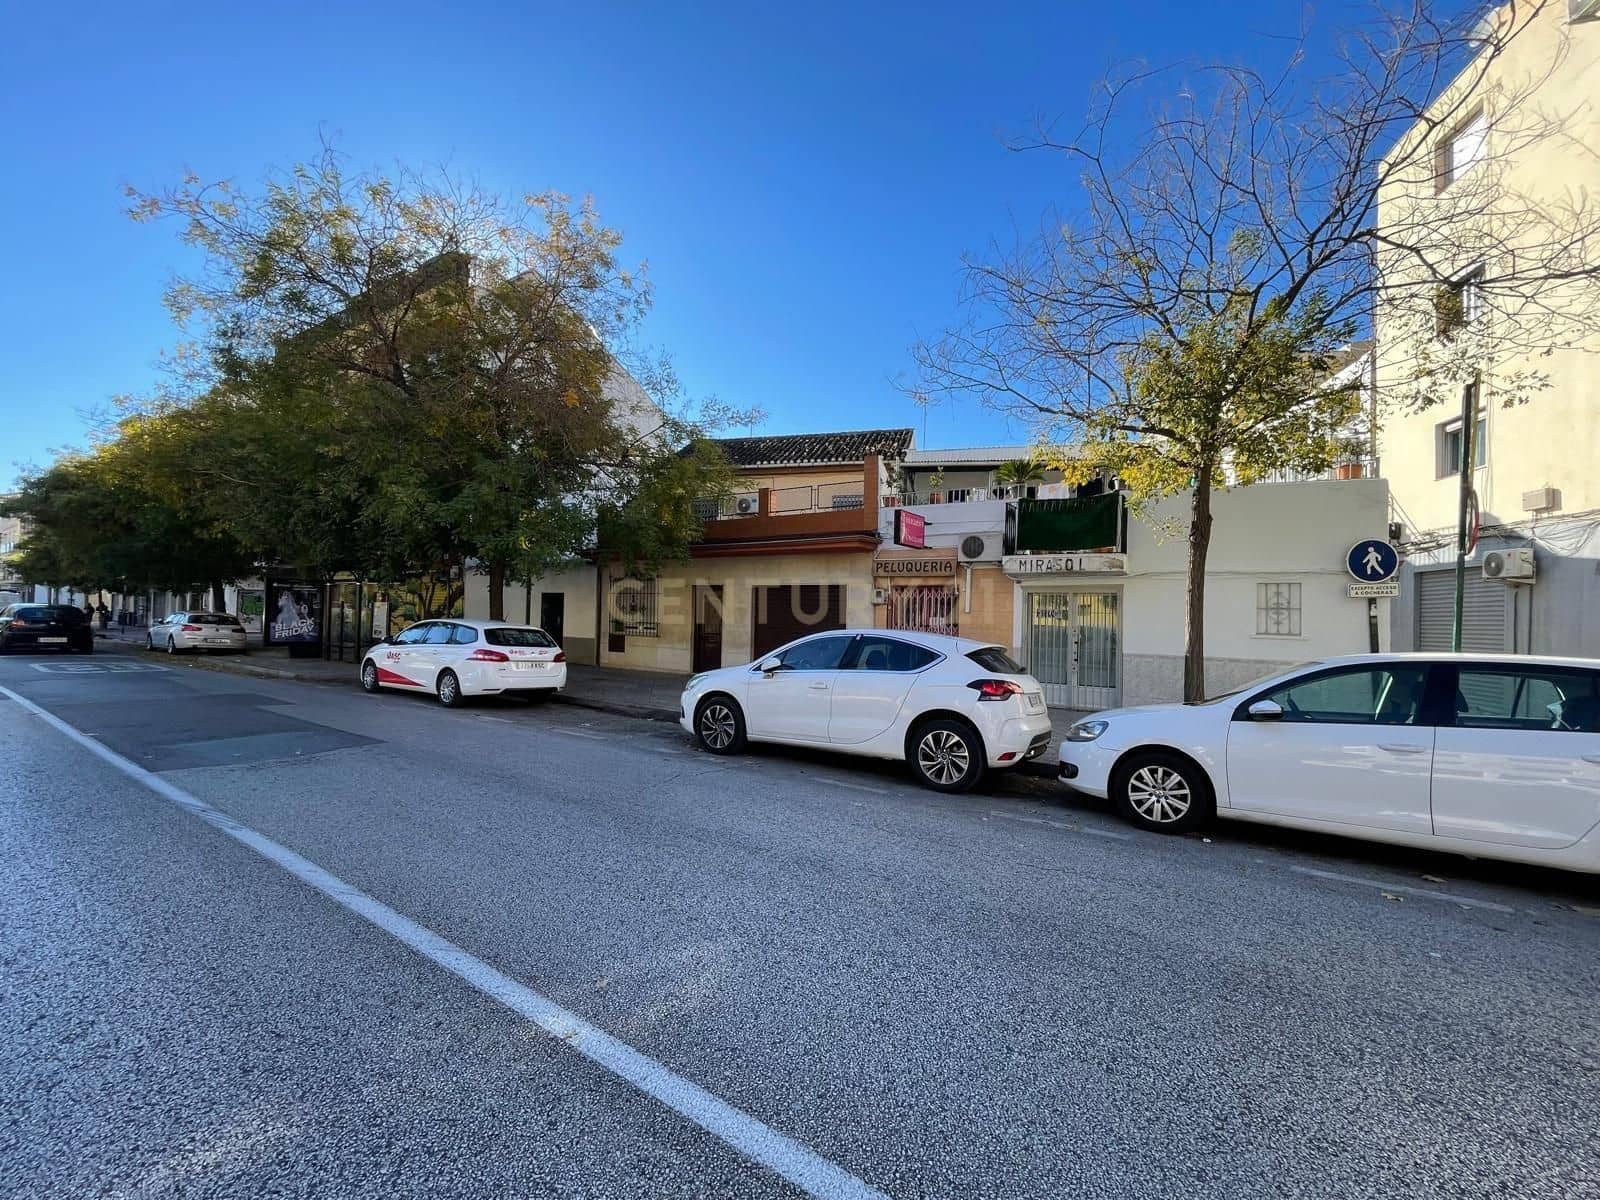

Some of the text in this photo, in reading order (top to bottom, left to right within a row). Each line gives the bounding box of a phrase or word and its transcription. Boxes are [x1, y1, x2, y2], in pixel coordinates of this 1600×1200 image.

[875, 561, 953, 574] PELUQUERIA
[1018, 558, 1086, 572] MIRASOL
[275, 617, 315, 631] BLACK
[274, 625, 315, 639] FRIDAY
